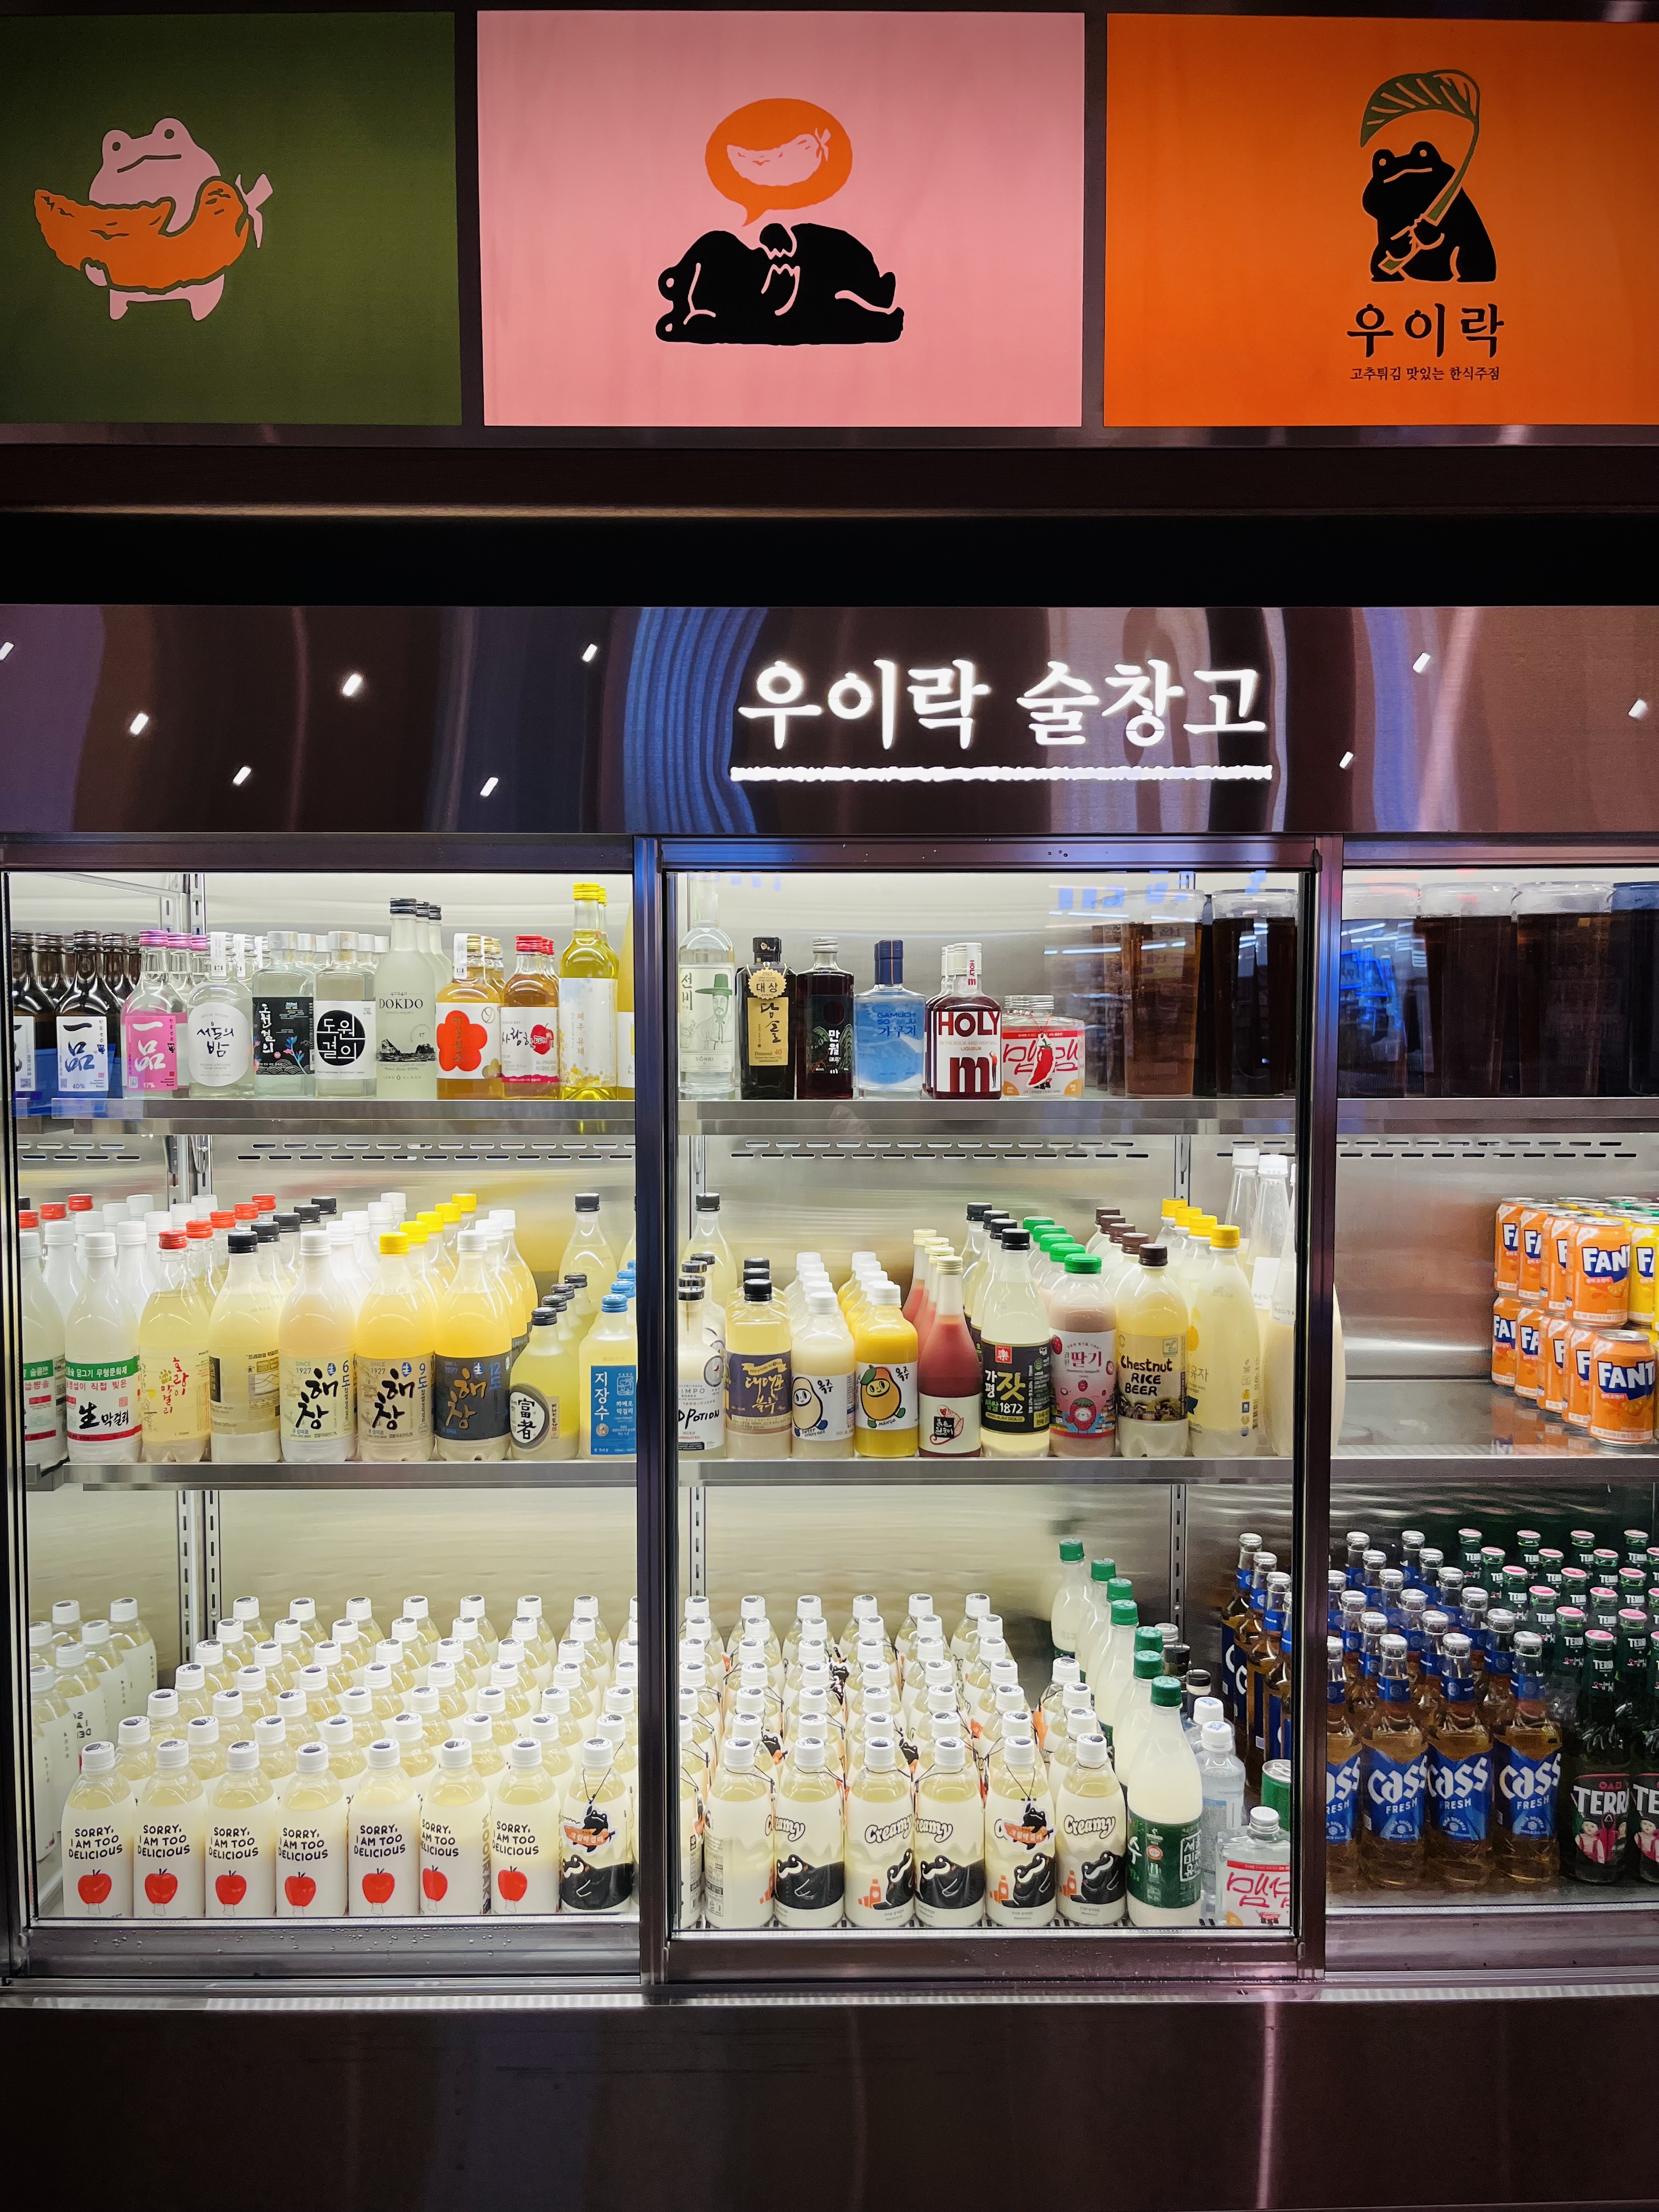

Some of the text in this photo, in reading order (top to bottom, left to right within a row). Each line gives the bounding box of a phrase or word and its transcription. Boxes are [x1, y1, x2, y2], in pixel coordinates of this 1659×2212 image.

[1347, 303, 1505, 358] 우이락
[1350, 366, 1500, 381] 고추튀김 맛있는 한식주점
[737, 658, 1267, 750] 우이락 술창고
[379, 998, 424, 1009] DOKDO
[197, 1022, 234, 1040] 서울의
[938, 1011, 1000, 1037] HOLY
[207, 1041, 229, 1057] 밤
[828, 1030, 840, 1056] 만월
[1583, 1245, 1630, 1273] FANT
[1071, 1351, 1102, 1368] 딸기
[1120, 1355, 1173, 1372] Chestnut
[1131, 1373, 1161, 1385] RICE
[1598, 1361, 1655, 1389] FANT
[91, 1382, 107, 1391] 직접
[112, 1379, 127, 1390] 빚은
[985, 1369, 997, 1398] 가평
[1125, 1382, 1158, 1396] BEER
[295, 1368, 338, 1430] 해창
[371, 1368, 415, 1430] 해창
[445, 1368, 487, 1429] 해창
[594, 1372, 610, 1421] 지장수
[752, 1396, 776, 1414] 블루
[1000, 1402, 1024, 1414] 1872
[101, 1409, 129, 1427] 막걸리
[517, 1398, 537, 1440] 富者
[685, 1408, 720, 1430] POTION
[878, 1418, 896, 1426] MANGO
[1386, 1798, 1418, 1814] FRESH
[1439, 1798, 1471, 1810] FRESH
[1516, 1795, 1550, 1810] FRESH
[1573, 1784, 1629, 1815] TERR
[75, 1825, 114, 1837] SORRY,
[143, 1824, 182, 1835] SORRY,
[214, 1826, 250, 1837] SORRY,
[283, 1827, 320, 1838] SORRY,
[360, 1823, 398, 1835] SORRY,
[422, 1819, 452, 1834] SORRY,
[496, 1820, 531, 1833] SORRY,
[865, 1813, 912, 1843] Creamy
[1064, 1814, 1116, 1839] Creamy
[76, 1839, 91, 1849] AM
[94, 1835, 119, 1847] TOO
[144, 1837, 158, 1846] AM
[162, 1835, 187, 1846] TOO
[215, 1838, 228, 1848] AM
[231, 1837, 255, 1848] TOO
[283, 1839, 297, 1850] AM
[301, 1839, 325, 1850] TOO
[360, 1837, 376, 1847] AM
[379, 1833, 403, 1845] TOO
[434, 1836, 456, 1846] TOO
[496, 1834, 509, 1844] AM
[512, 1835, 535, 1844] TOO
[69, 1844, 123, 1860] DELICIOUS
[138, 1844, 190, 1858] DELICIOUS
[209, 1847, 259, 1860] DELICIOUS
[278, 1847, 329, 1861] DELICIOUS
[354, 1843, 405, 1858] DELICIOUS
[492, 1839, 539, 1856] DELICIOUS
